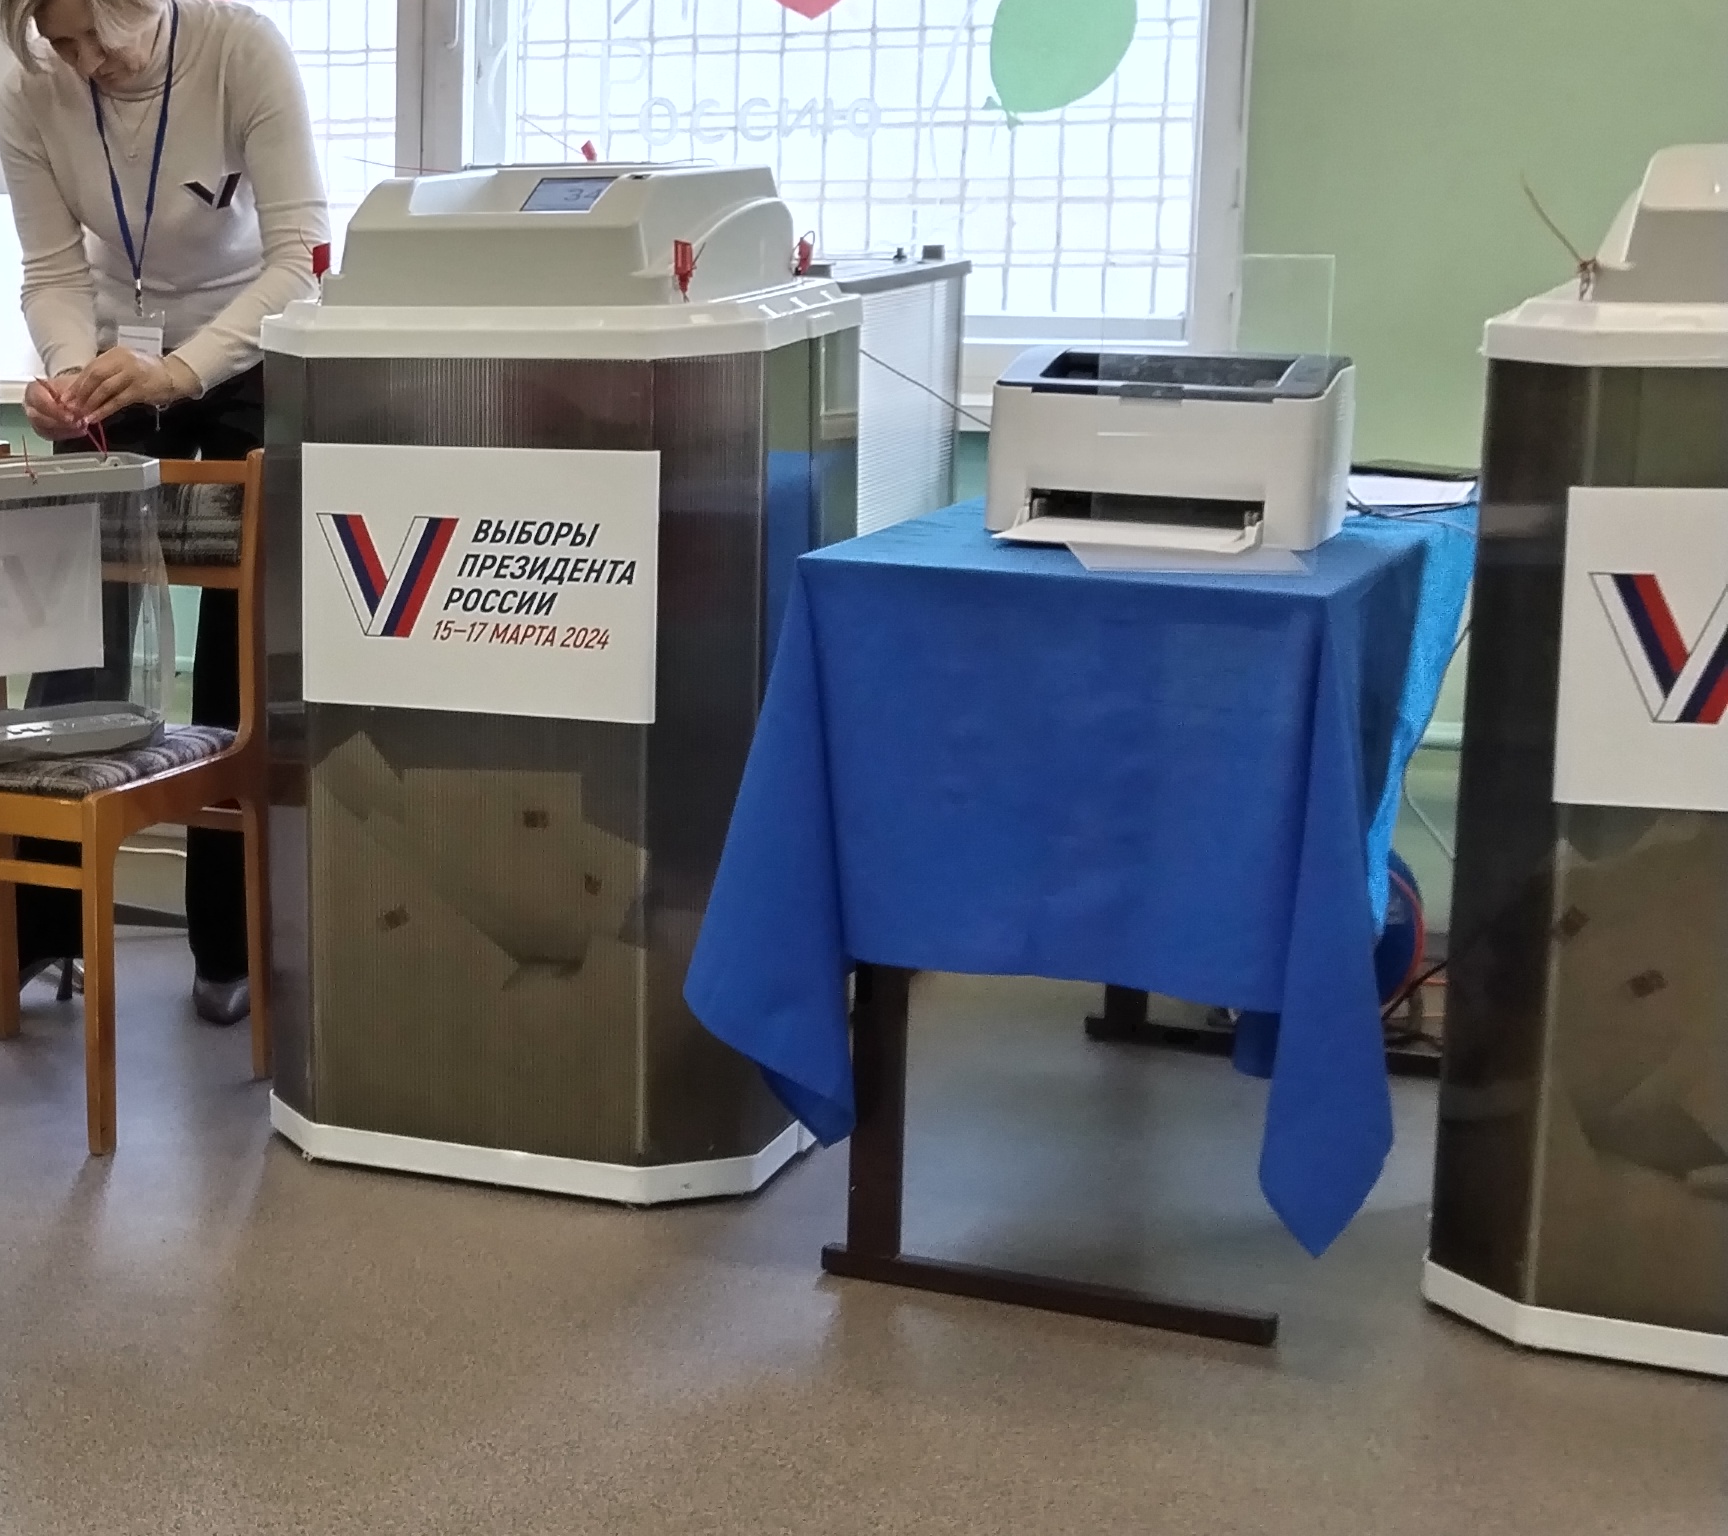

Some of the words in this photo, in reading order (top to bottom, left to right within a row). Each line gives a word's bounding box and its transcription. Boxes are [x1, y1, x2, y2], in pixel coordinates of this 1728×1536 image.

[600, 39, 882, 152] Россию
[471, 519, 601, 548] ВЫБОРЫ
[456, 553, 637, 586] ПРЕЗИДЕНТА
[443, 586, 559, 617] РОССИИ
[488, 623, 558, 647] МАРТА
[559, 626, 610, 651] 2024
